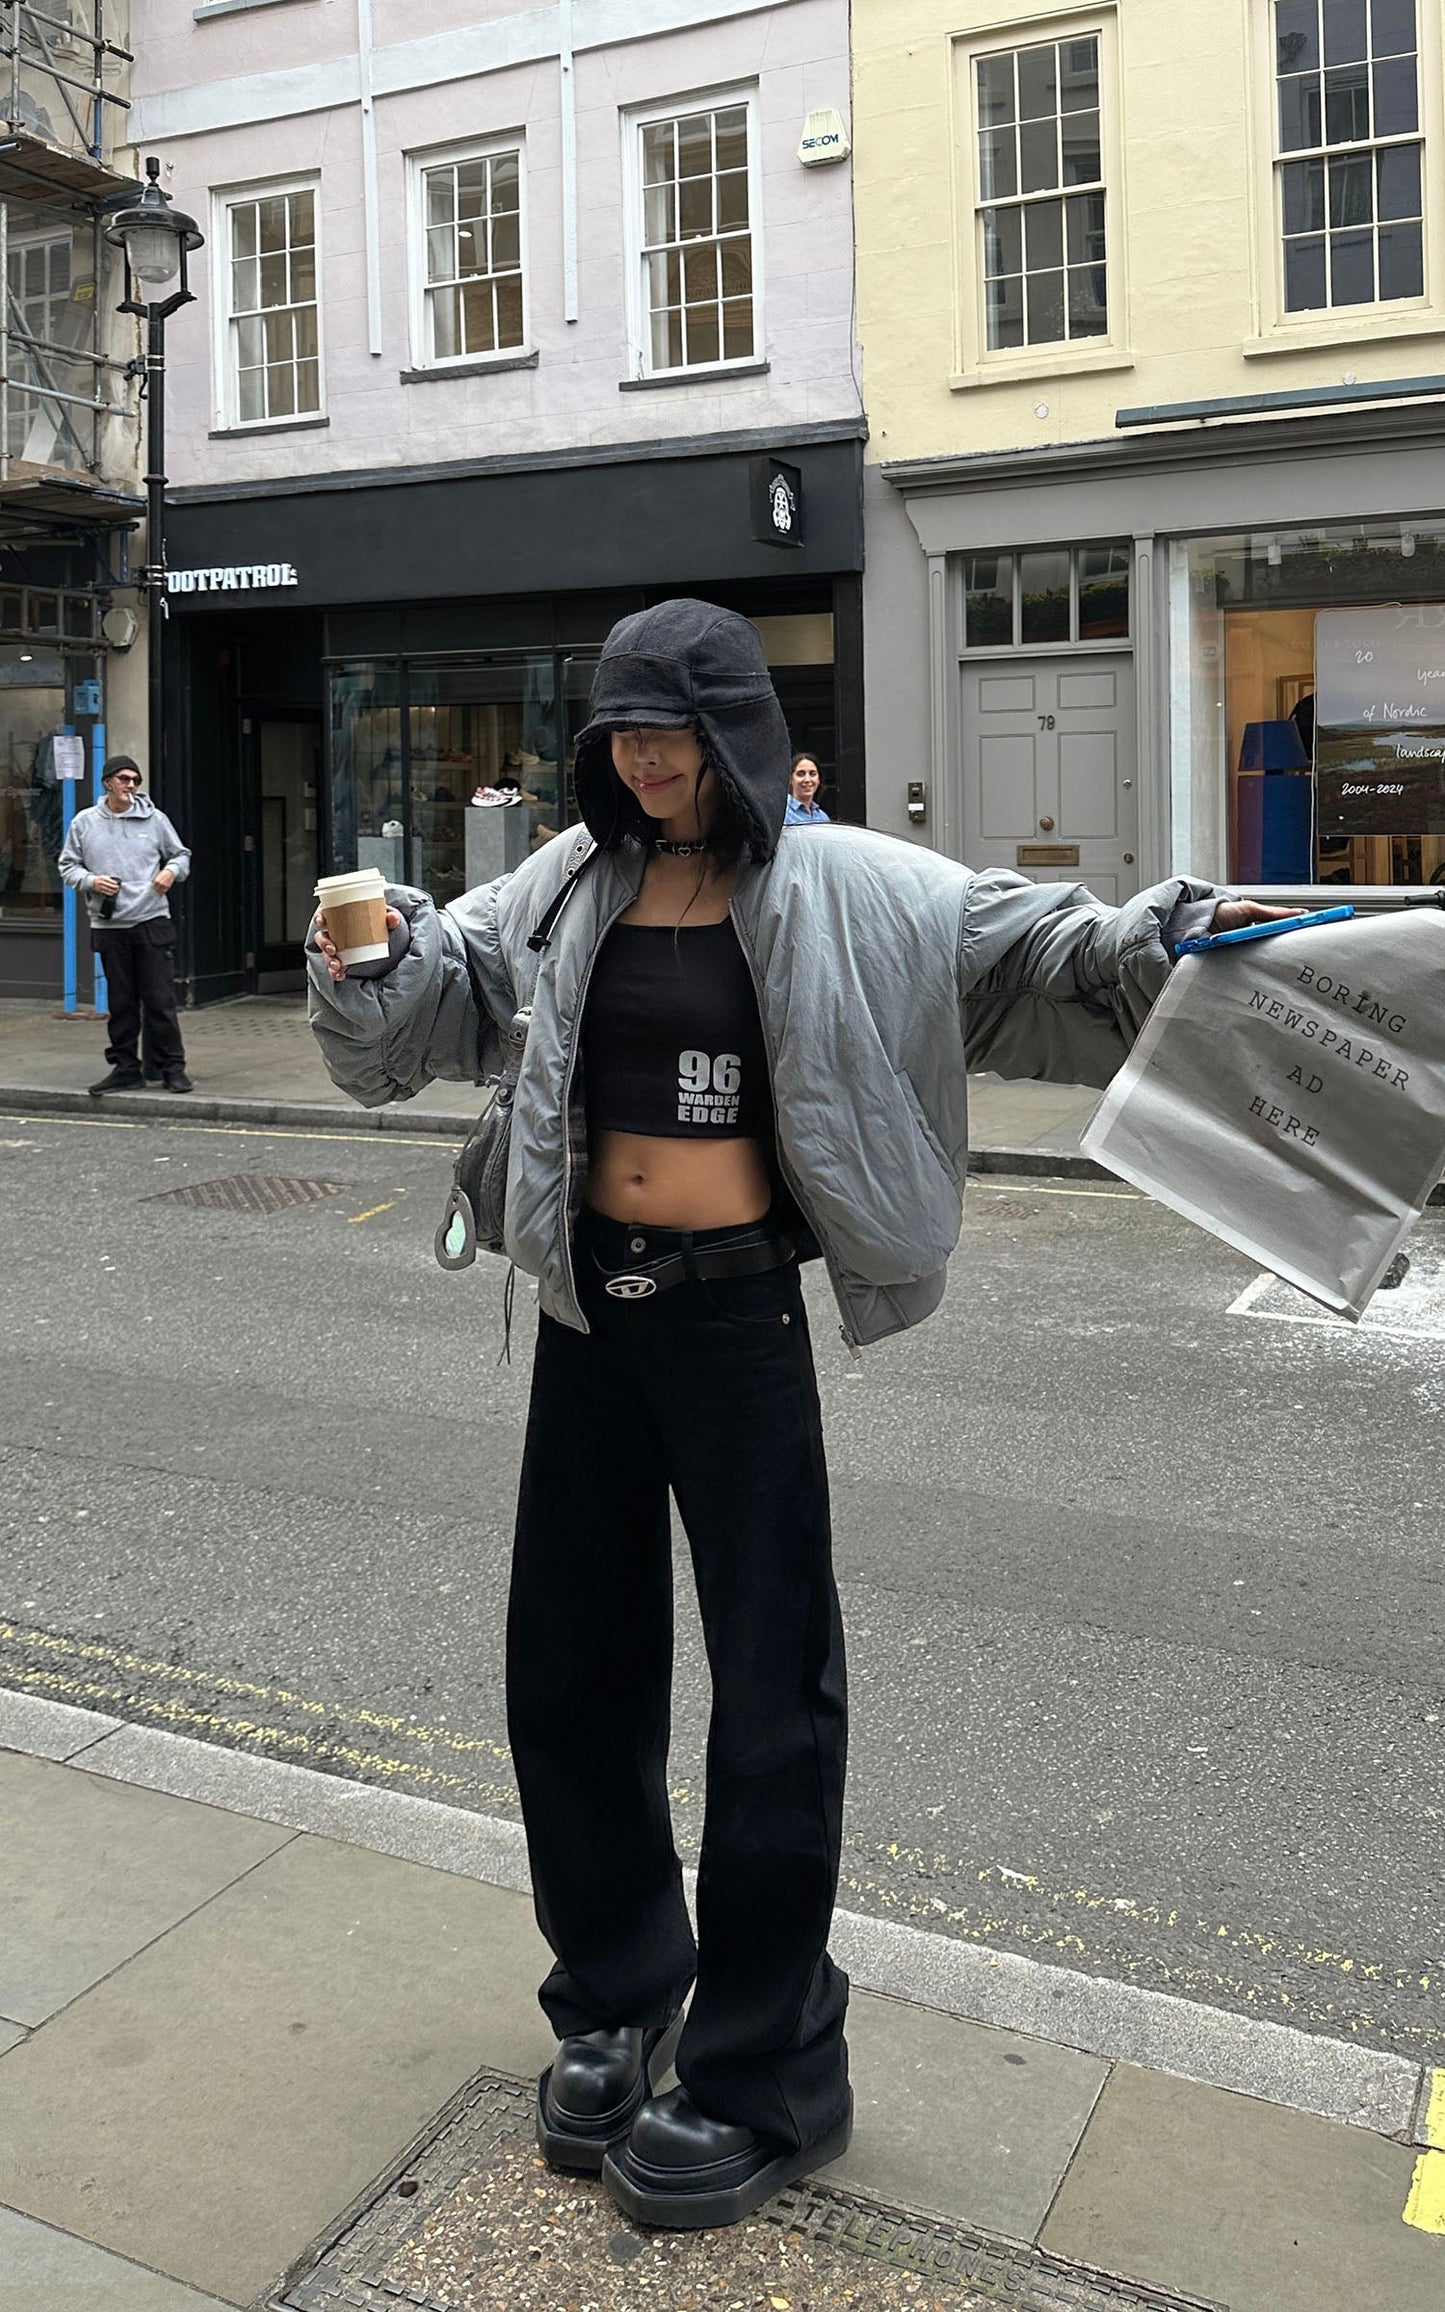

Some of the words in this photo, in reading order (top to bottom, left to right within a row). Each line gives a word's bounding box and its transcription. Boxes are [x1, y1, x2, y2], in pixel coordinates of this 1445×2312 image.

[802, 133, 839, 150] SECOM
[164, 563, 298, 593] OOTPATROL
[1355, 650, 1374, 664] 20
[1037, 714, 1056, 731] 79
[1363, 704, 1376, 723] of
[1383, 702, 1428, 720] Nordic
[1341, 782, 1404, 796] 2004-2024
[1297, 965, 1407, 1033] BORING
[1248, 991, 1409, 1091] NEWSPAPER
[678, 1050, 742, 1094] 96
[1286, 1065, 1324, 1094] AD
[678, 1092, 740, 1106] WARDEN
[677, 1104, 739, 1124] EDGE
[1248, 1096, 1320, 1147] HERE
[803, 2202, 1026, 2292] TELEPHONES
